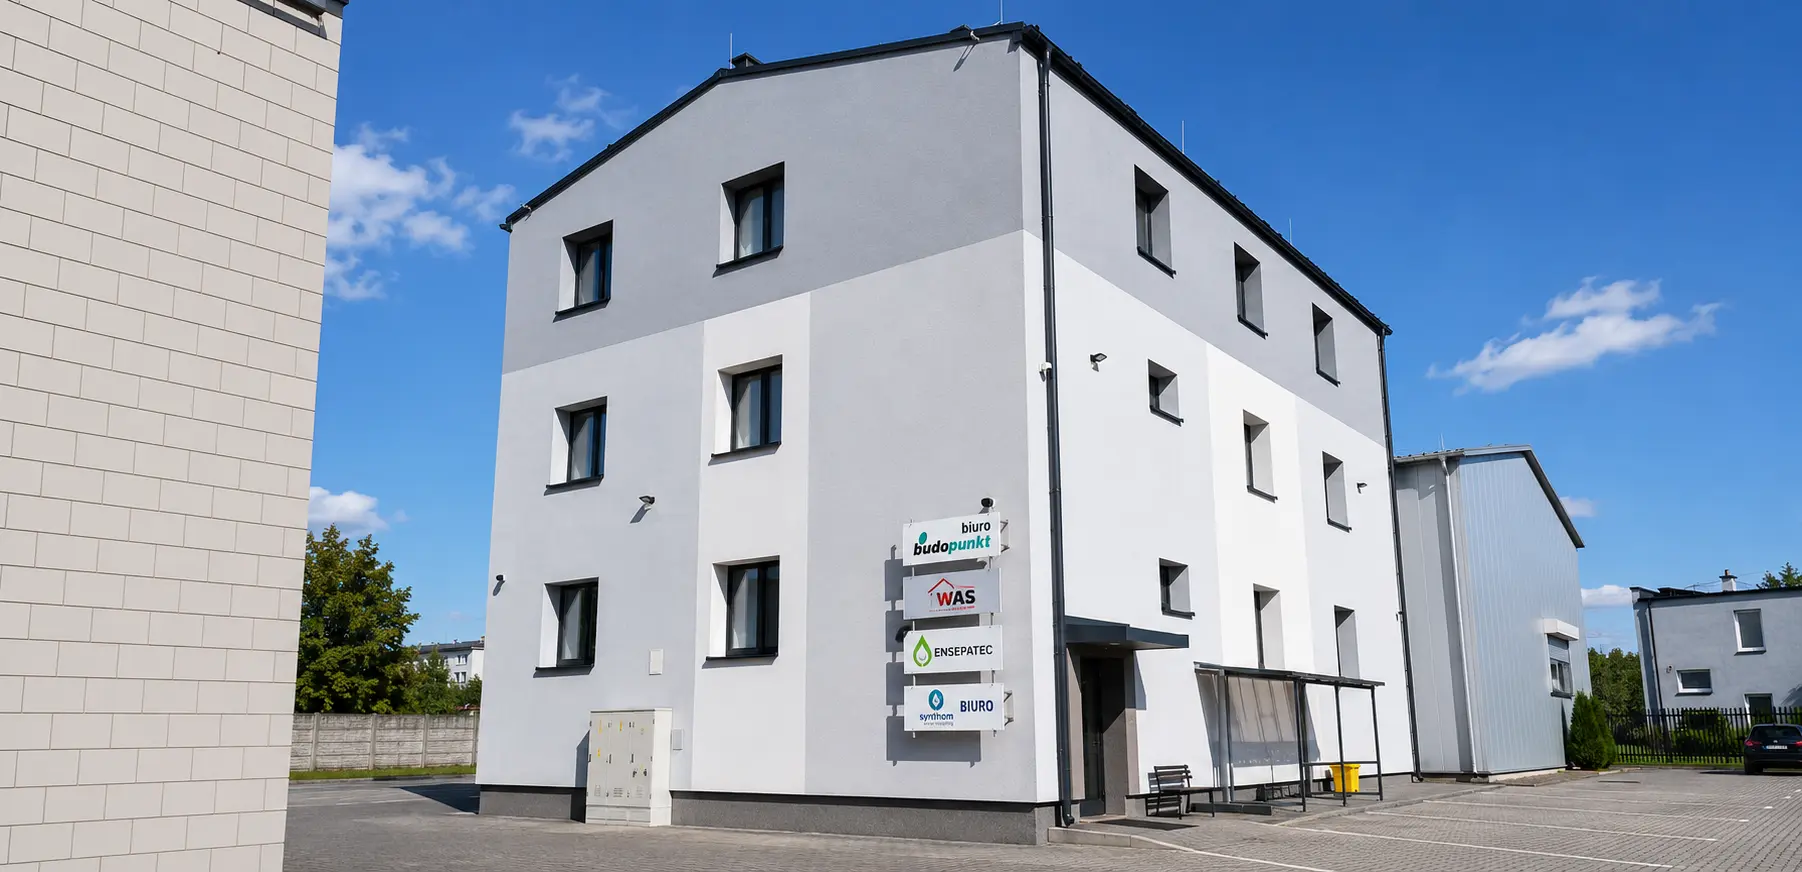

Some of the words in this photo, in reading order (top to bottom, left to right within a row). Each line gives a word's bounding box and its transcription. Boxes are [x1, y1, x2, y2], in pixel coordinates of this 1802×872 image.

[961, 521, 991, 534] biuro
[913, 535, 991, 556] budopunkt
[936, 589, 976, 607] WAS
[934, 644, 993, 658] ENSEPATEC
[960, 700, 994, 712] BIURO
